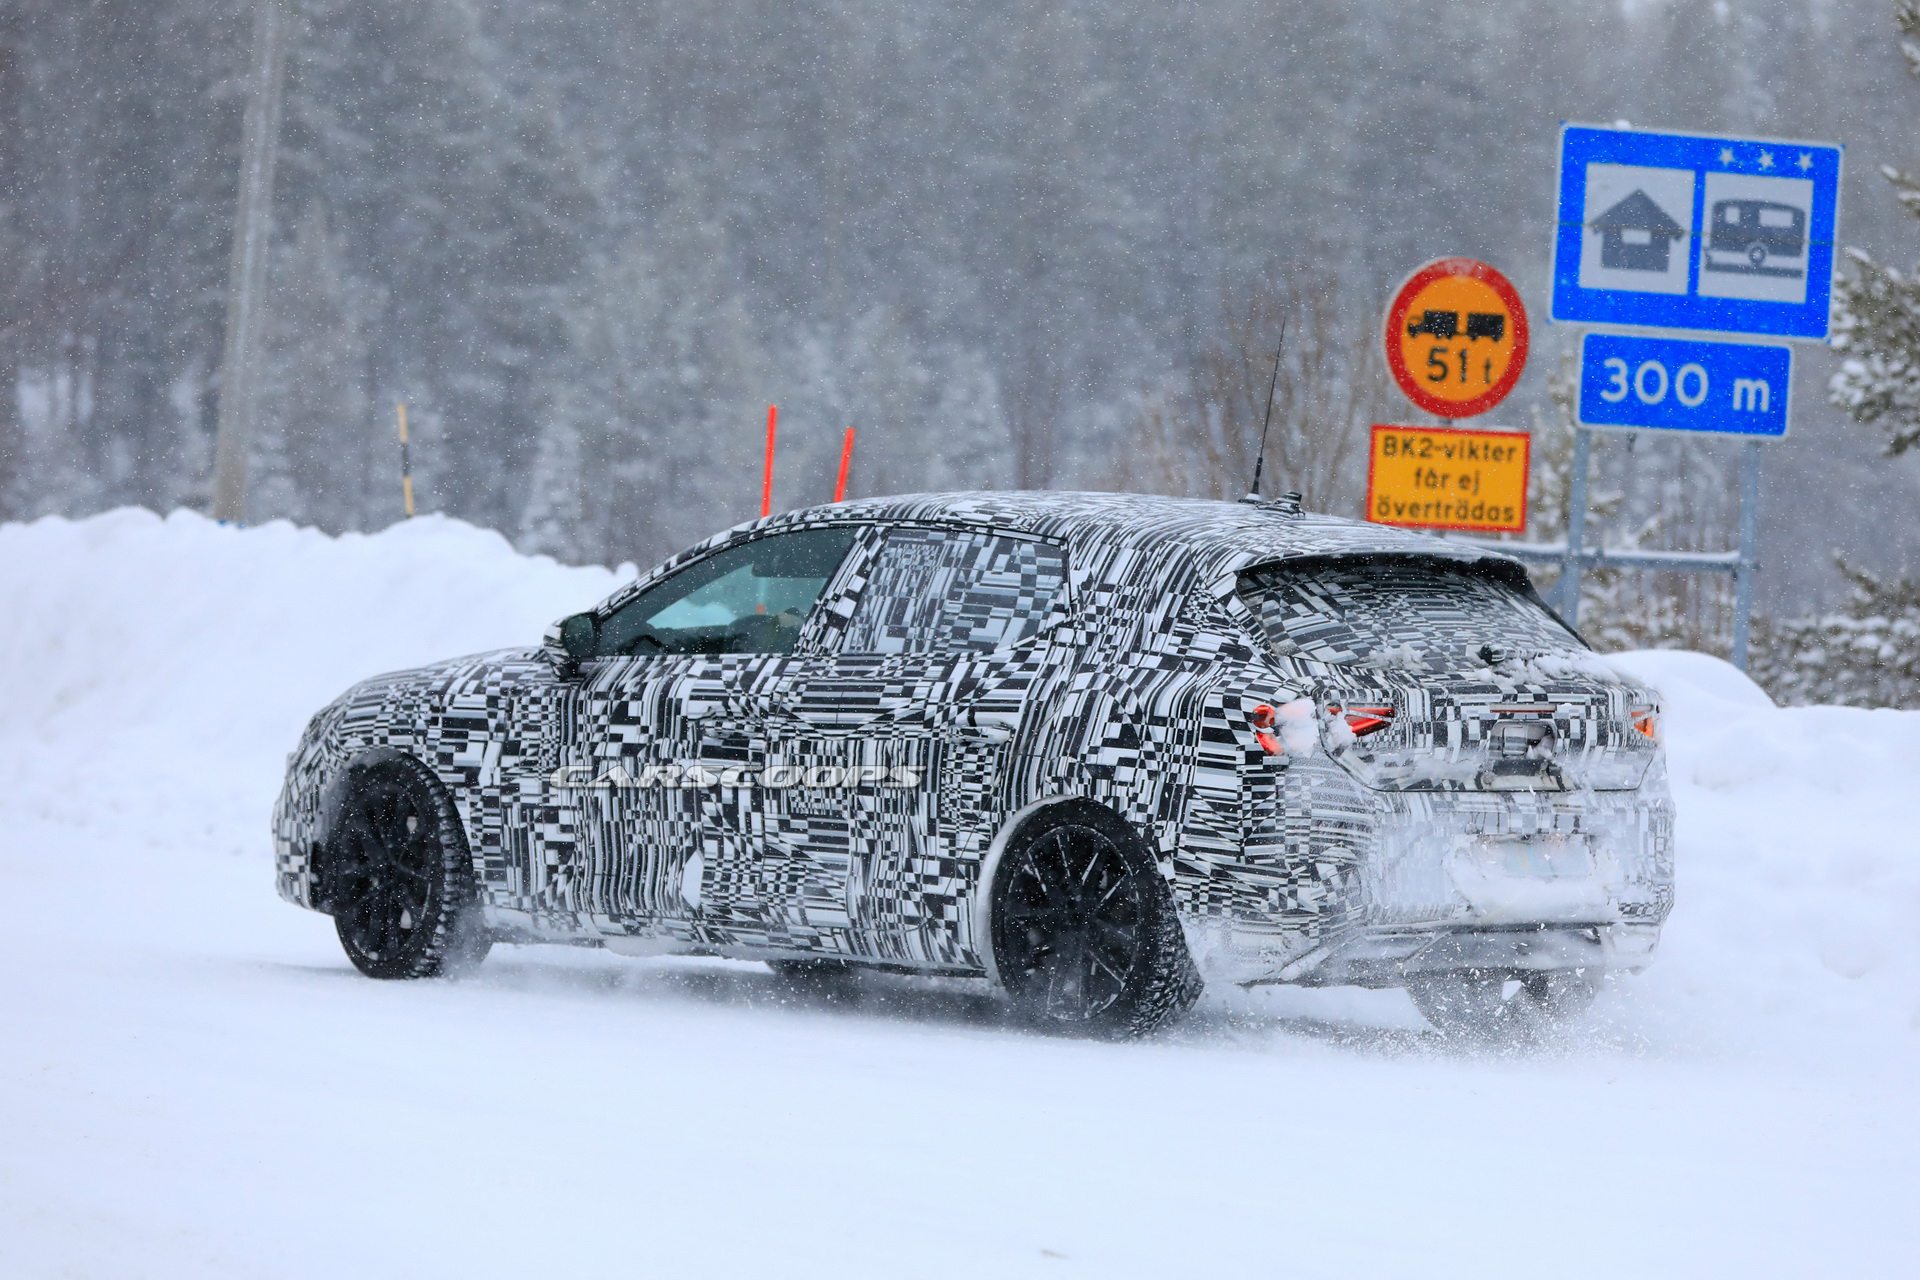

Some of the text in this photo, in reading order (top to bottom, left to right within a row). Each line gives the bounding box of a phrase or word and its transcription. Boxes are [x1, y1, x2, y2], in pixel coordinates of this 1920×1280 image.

[1427, 346, 1494, 384] 51 t
[1600, 357, 1771, 413] 300 m
[1382, 434, 1516, 462] BK2-vikter
[1458, 469, 1480, 495] ej
[1376, 495, 1515, 522] överträdas
